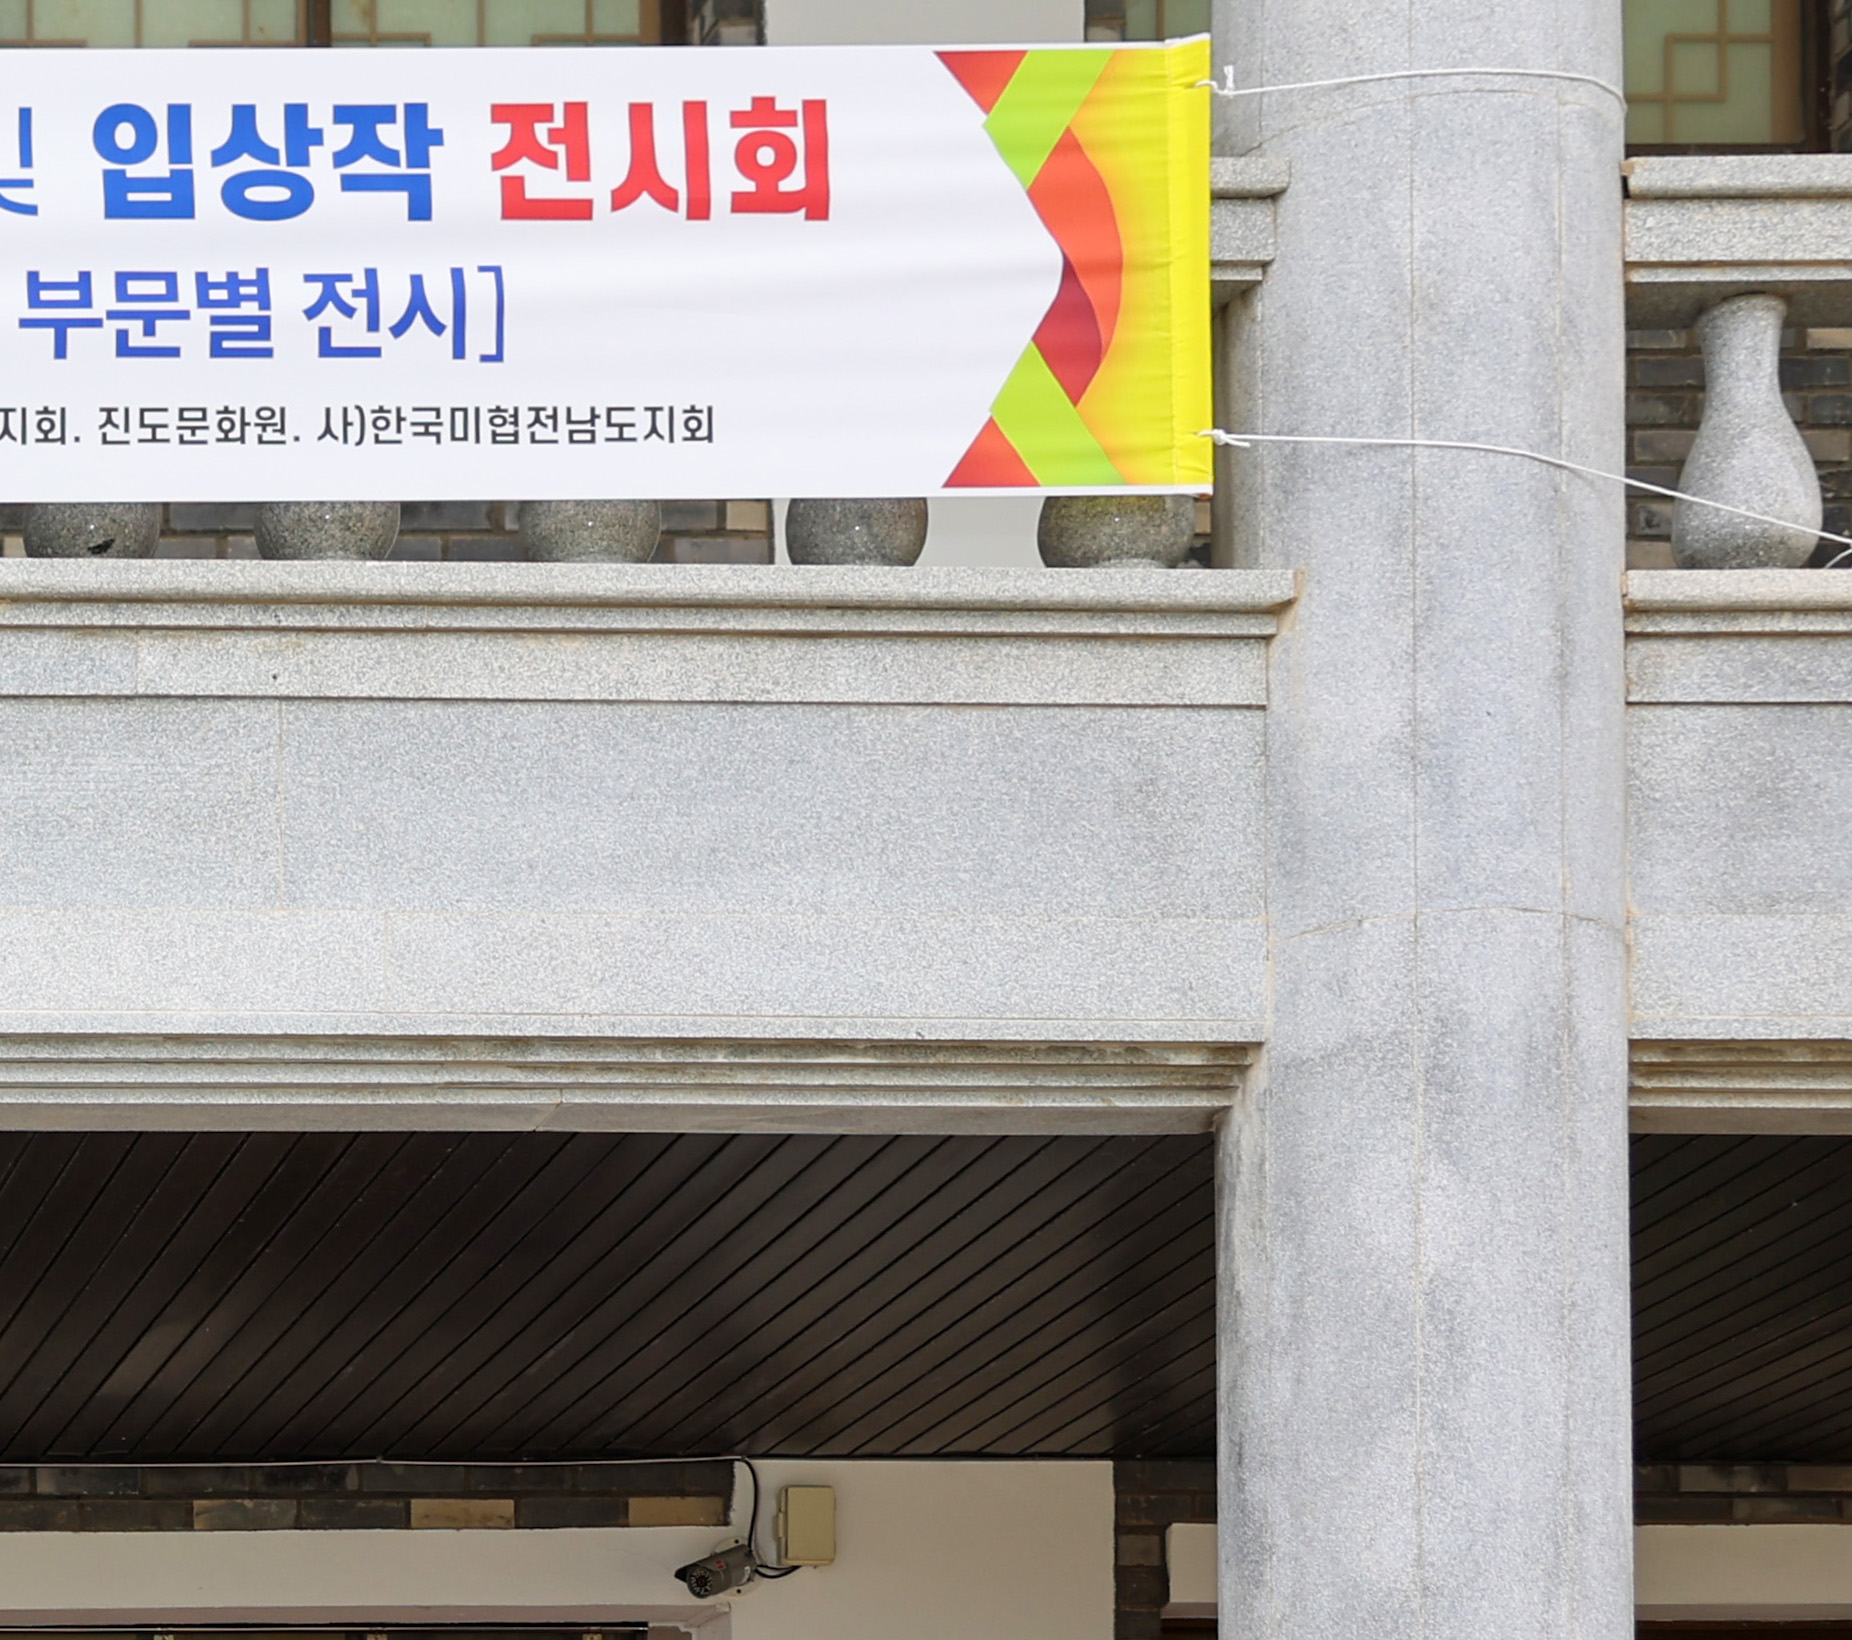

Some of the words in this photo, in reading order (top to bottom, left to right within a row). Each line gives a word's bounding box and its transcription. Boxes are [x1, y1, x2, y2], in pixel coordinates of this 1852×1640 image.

[93, 102, 445, 222] 입상작
[491, 97, 831, 222] 전시회
[19, 267, 274, 360] 부문별
[302, 264, 505, 363] 전시]
[99, 405, 300, 446] 진도문화원.
[318, 404, 714, 447] 사)한국미협전남도지회
